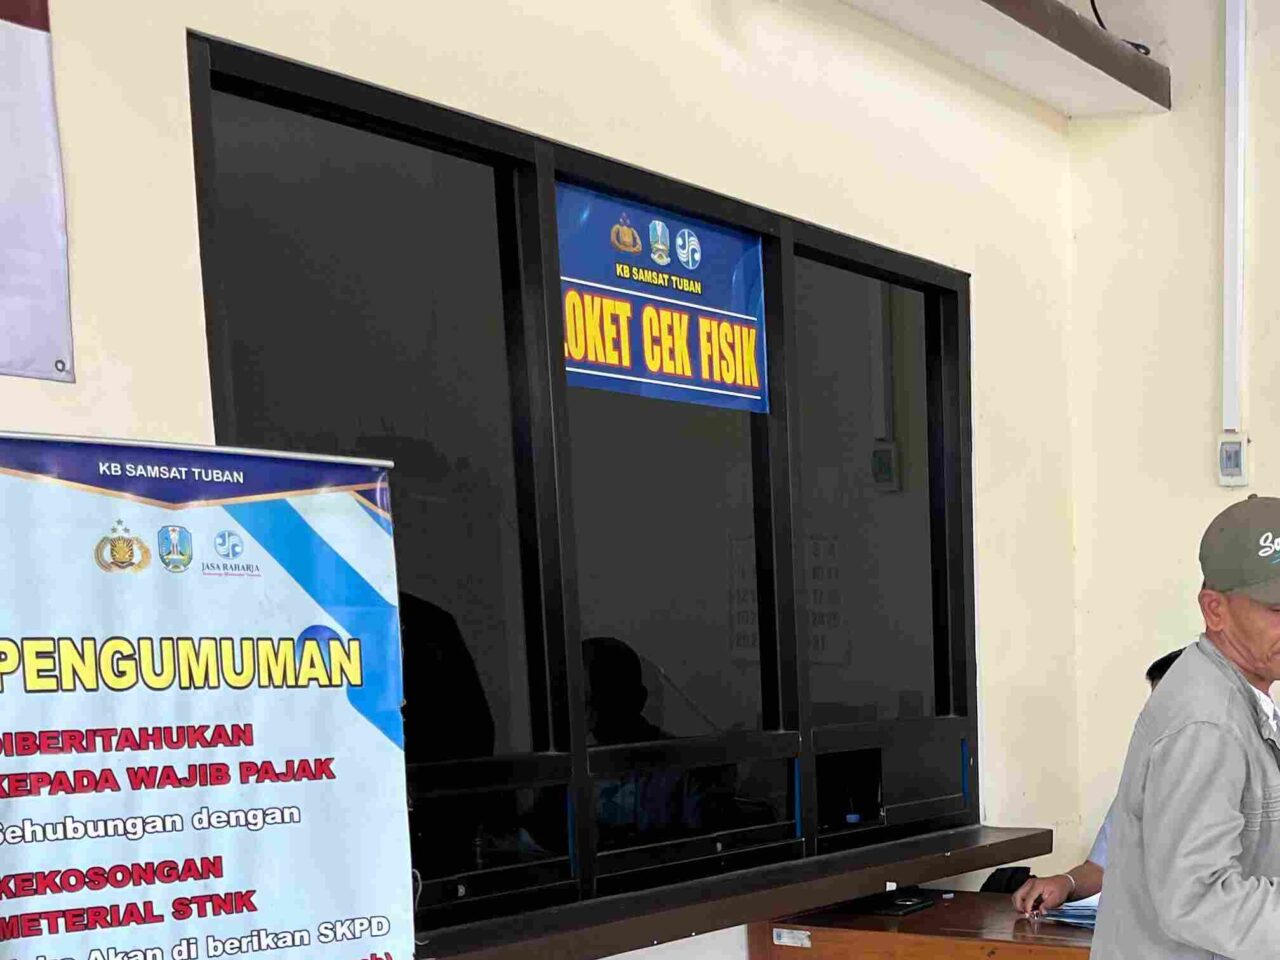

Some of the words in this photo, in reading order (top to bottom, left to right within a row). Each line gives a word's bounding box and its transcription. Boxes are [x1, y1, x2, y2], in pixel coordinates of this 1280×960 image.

[615, 262, 630, 279] KB
[632, 266, 669, 287] SAMSAT
[671, 276, 702, 295] TUBAN
[564, 288, 632, 369] OKET
[641, 304, 693, 378] CEK
[698, 316, 760, 389] FISIK
[99, 462, 121, 476] KB
[126, 464, 188, 480] SAMSAT
[192, 468, 244, 484] TUBAN
[202, 562, 221, 571] JASA
[222, 562, 260, 573] RAHARJA
[0, 636, 363, 693] PENGUMUMAN
[0, 723, 254, 757] IBERITAHUKAN
[127, 762, 231, 792] WAJIB
[239, 757, 336, 783] PAJAK
[0, 812, 183, 845] ehubungan
[192, 805, 301, 833] dengan
[0, 901, 164, 941] METERIAL
[172, 890, 258, 919] STNK
[207, 927, 310, 958] berikan
[318, 915, 391, 944] SKPD
